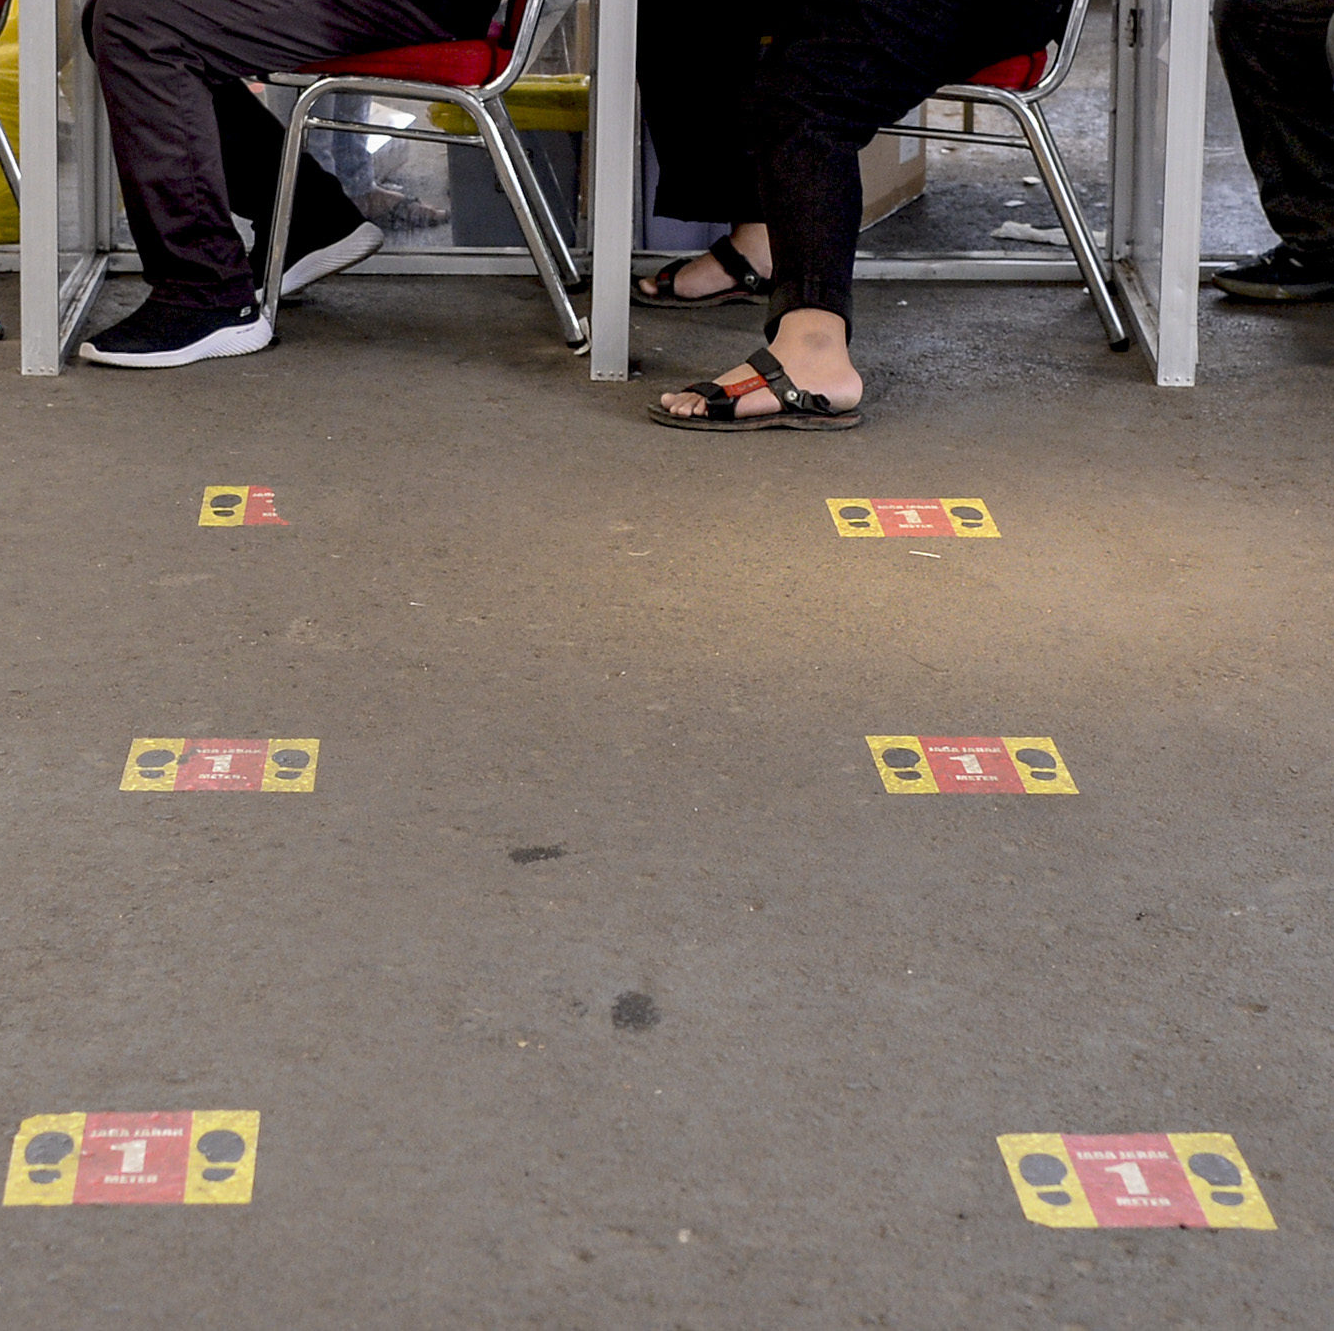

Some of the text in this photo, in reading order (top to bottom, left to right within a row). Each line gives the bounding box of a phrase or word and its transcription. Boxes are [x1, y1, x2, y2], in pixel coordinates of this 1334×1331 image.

[894, 509, 922, 524] 1
[204, 754, 233, 773] 1
[948, 754, 984, 774] 1
[109, 1139, 148, 1173] 1
[1104, 1161, 1151, 1196] 1
